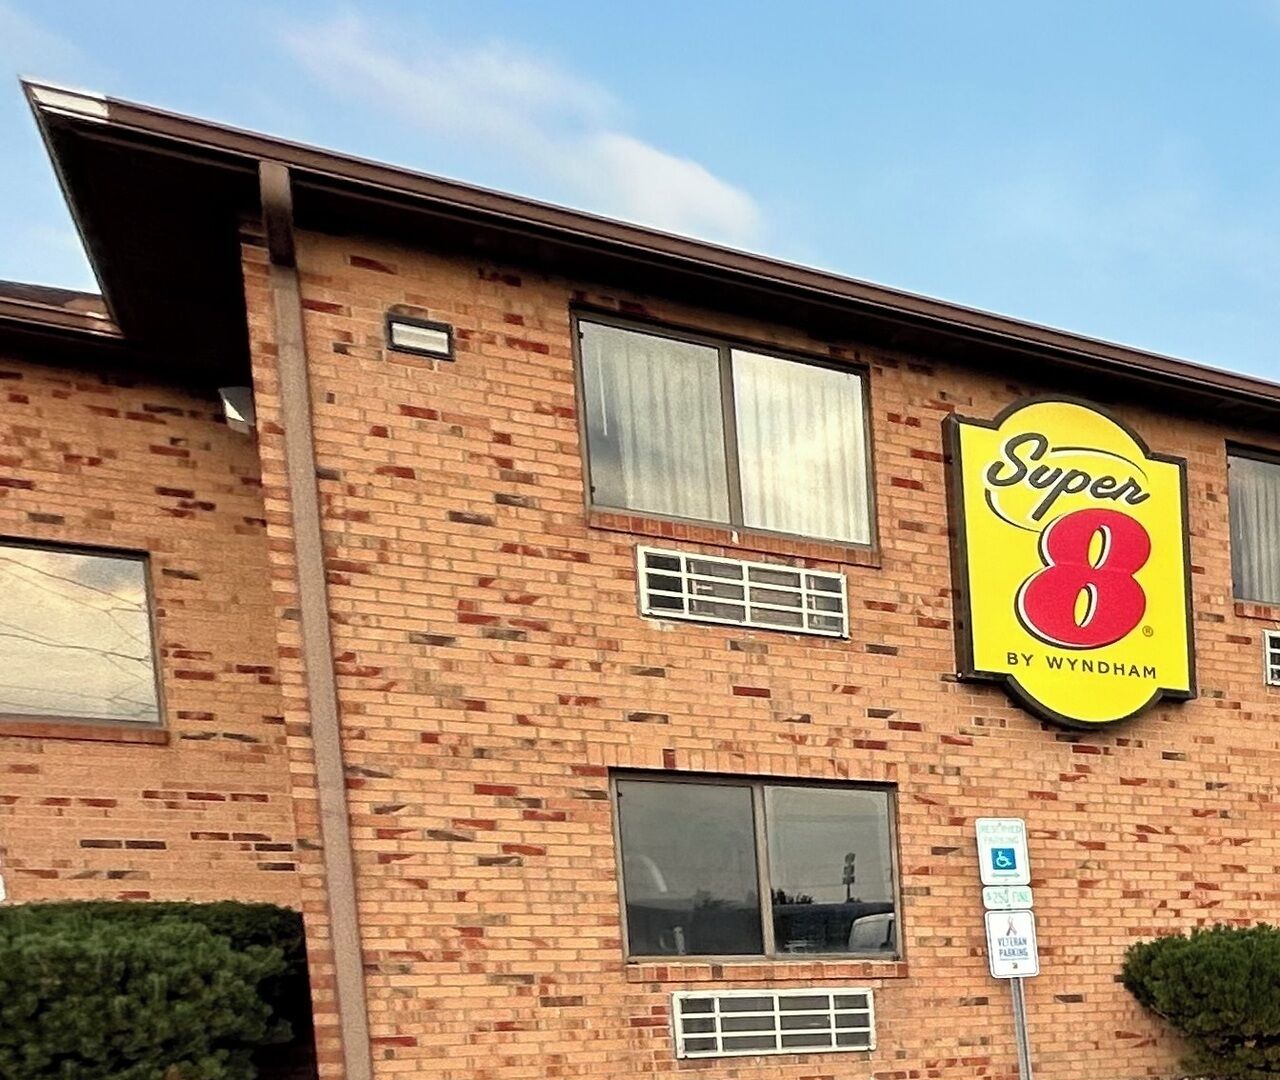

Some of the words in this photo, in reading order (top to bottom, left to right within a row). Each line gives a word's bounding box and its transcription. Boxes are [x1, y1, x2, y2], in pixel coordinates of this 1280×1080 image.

[987, 432, 1150, 521] Super
[1015, 508, 1151, 650] 8
[1007, 652, 1033, 667] BY
[1046, 655, 1156, 679] WYNDHAM
[997, 937, 1027, 947] VETERAN
[999, 948, 1028, 957] PARKING
